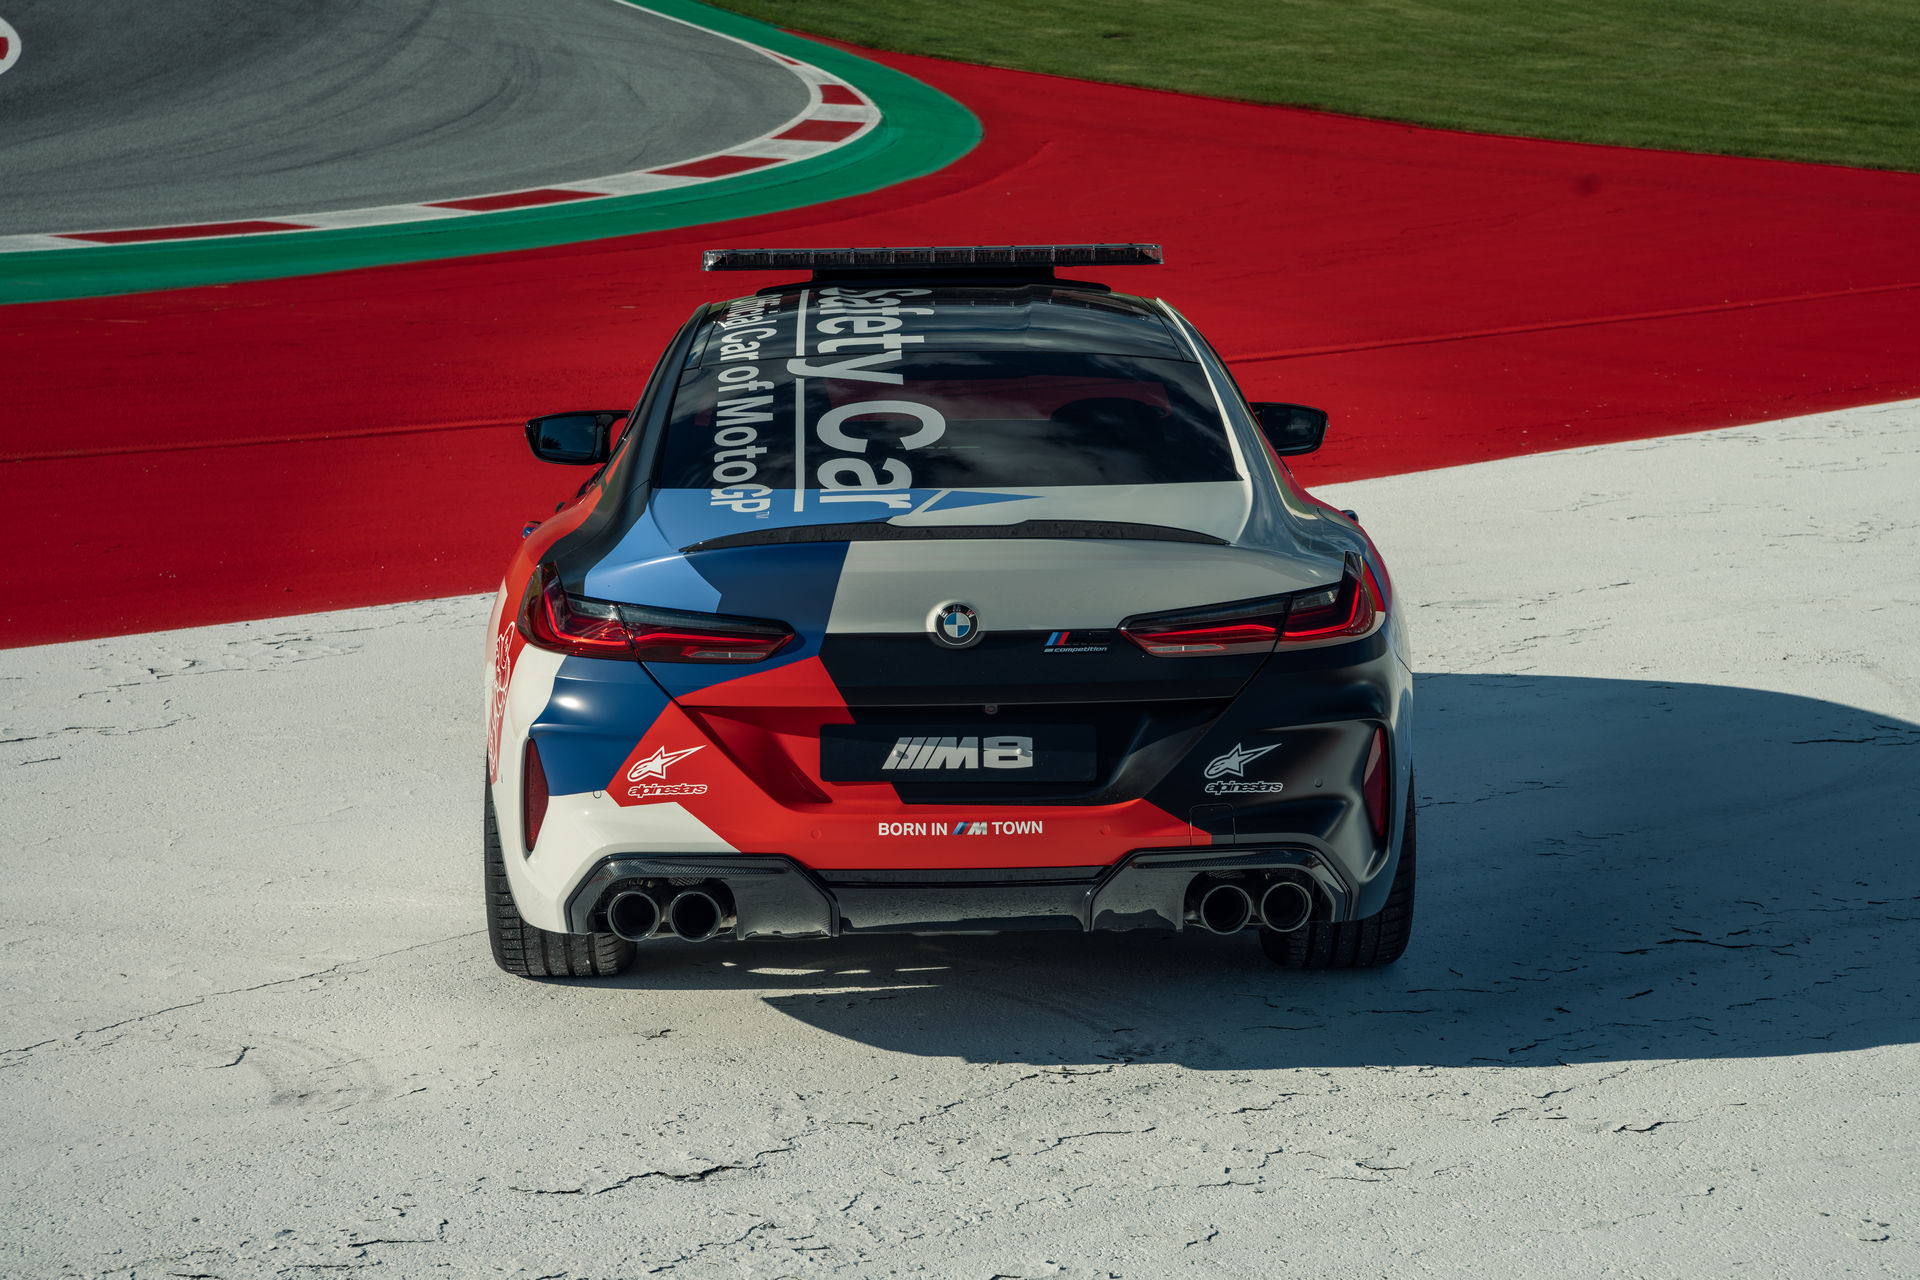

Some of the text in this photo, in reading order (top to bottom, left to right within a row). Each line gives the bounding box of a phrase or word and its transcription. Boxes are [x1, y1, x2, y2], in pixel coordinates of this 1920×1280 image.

[720, 328, 777, 361] Car
[718, 366, 774, 392] of
[787, 287, 946, 508] Safety Car
[628, 783, 708, 798] alpinestars
[1204, 781, 1283, 795] alpinestars
[878, 822, 927, 836] BORN
[931, 822, 948, 836] IN
[992, 821, 1043, 835] TOWN
